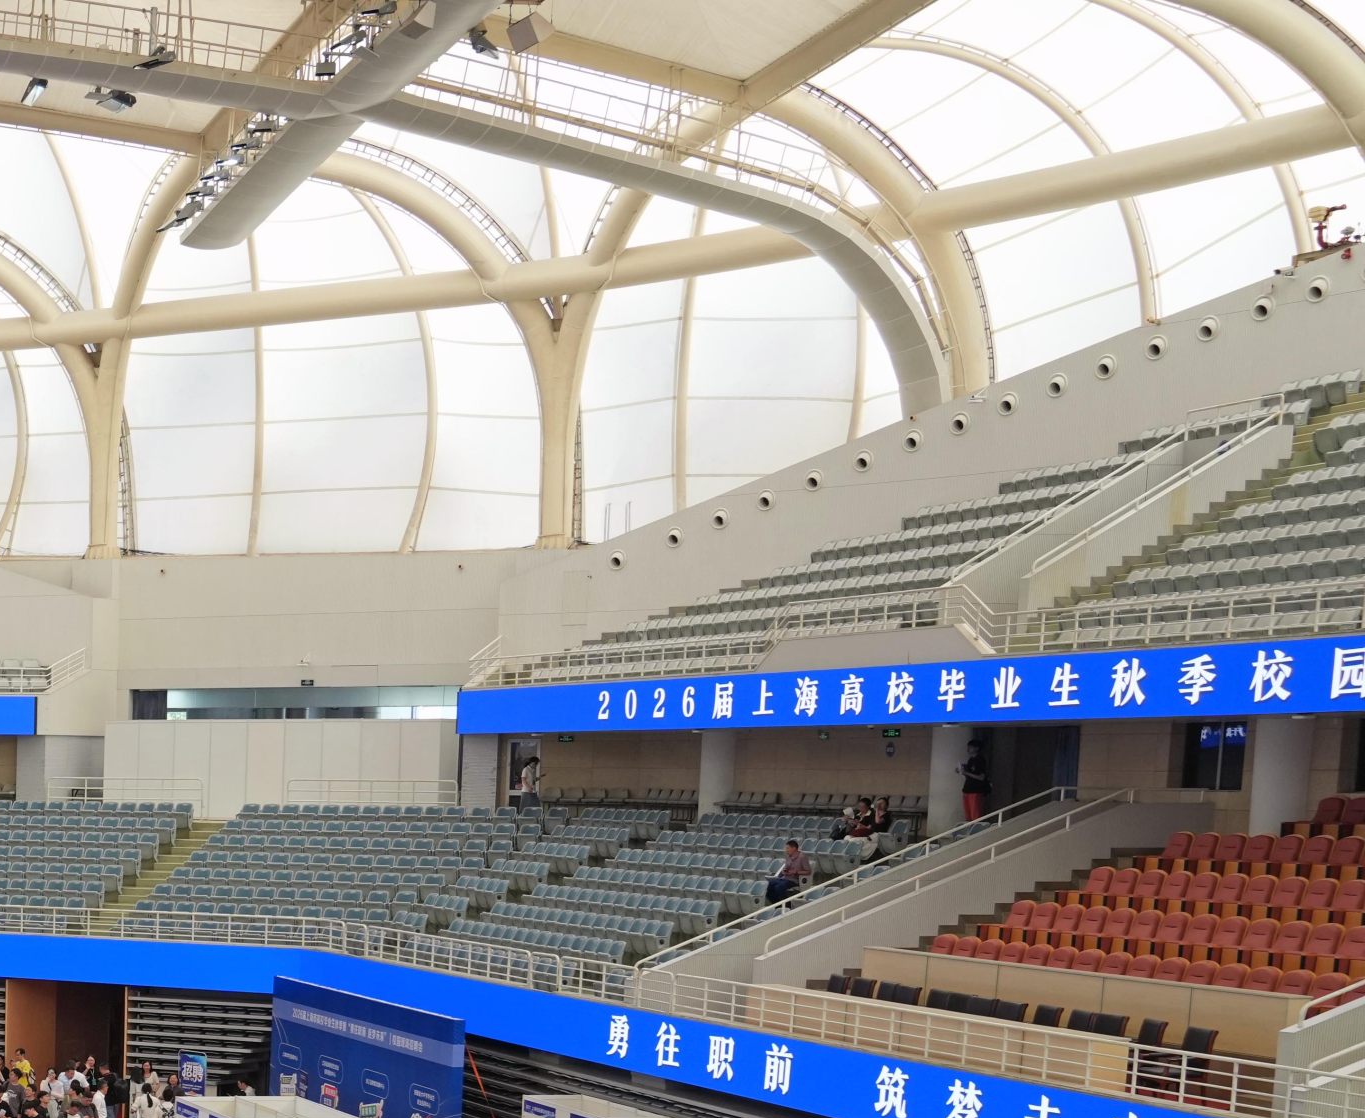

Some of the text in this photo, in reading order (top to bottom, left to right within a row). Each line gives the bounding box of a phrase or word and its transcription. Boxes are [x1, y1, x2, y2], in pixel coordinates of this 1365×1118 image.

[181, 1063, 204, 1080] 招聘
[607, 1014, 794, 1096] 勇往职前
